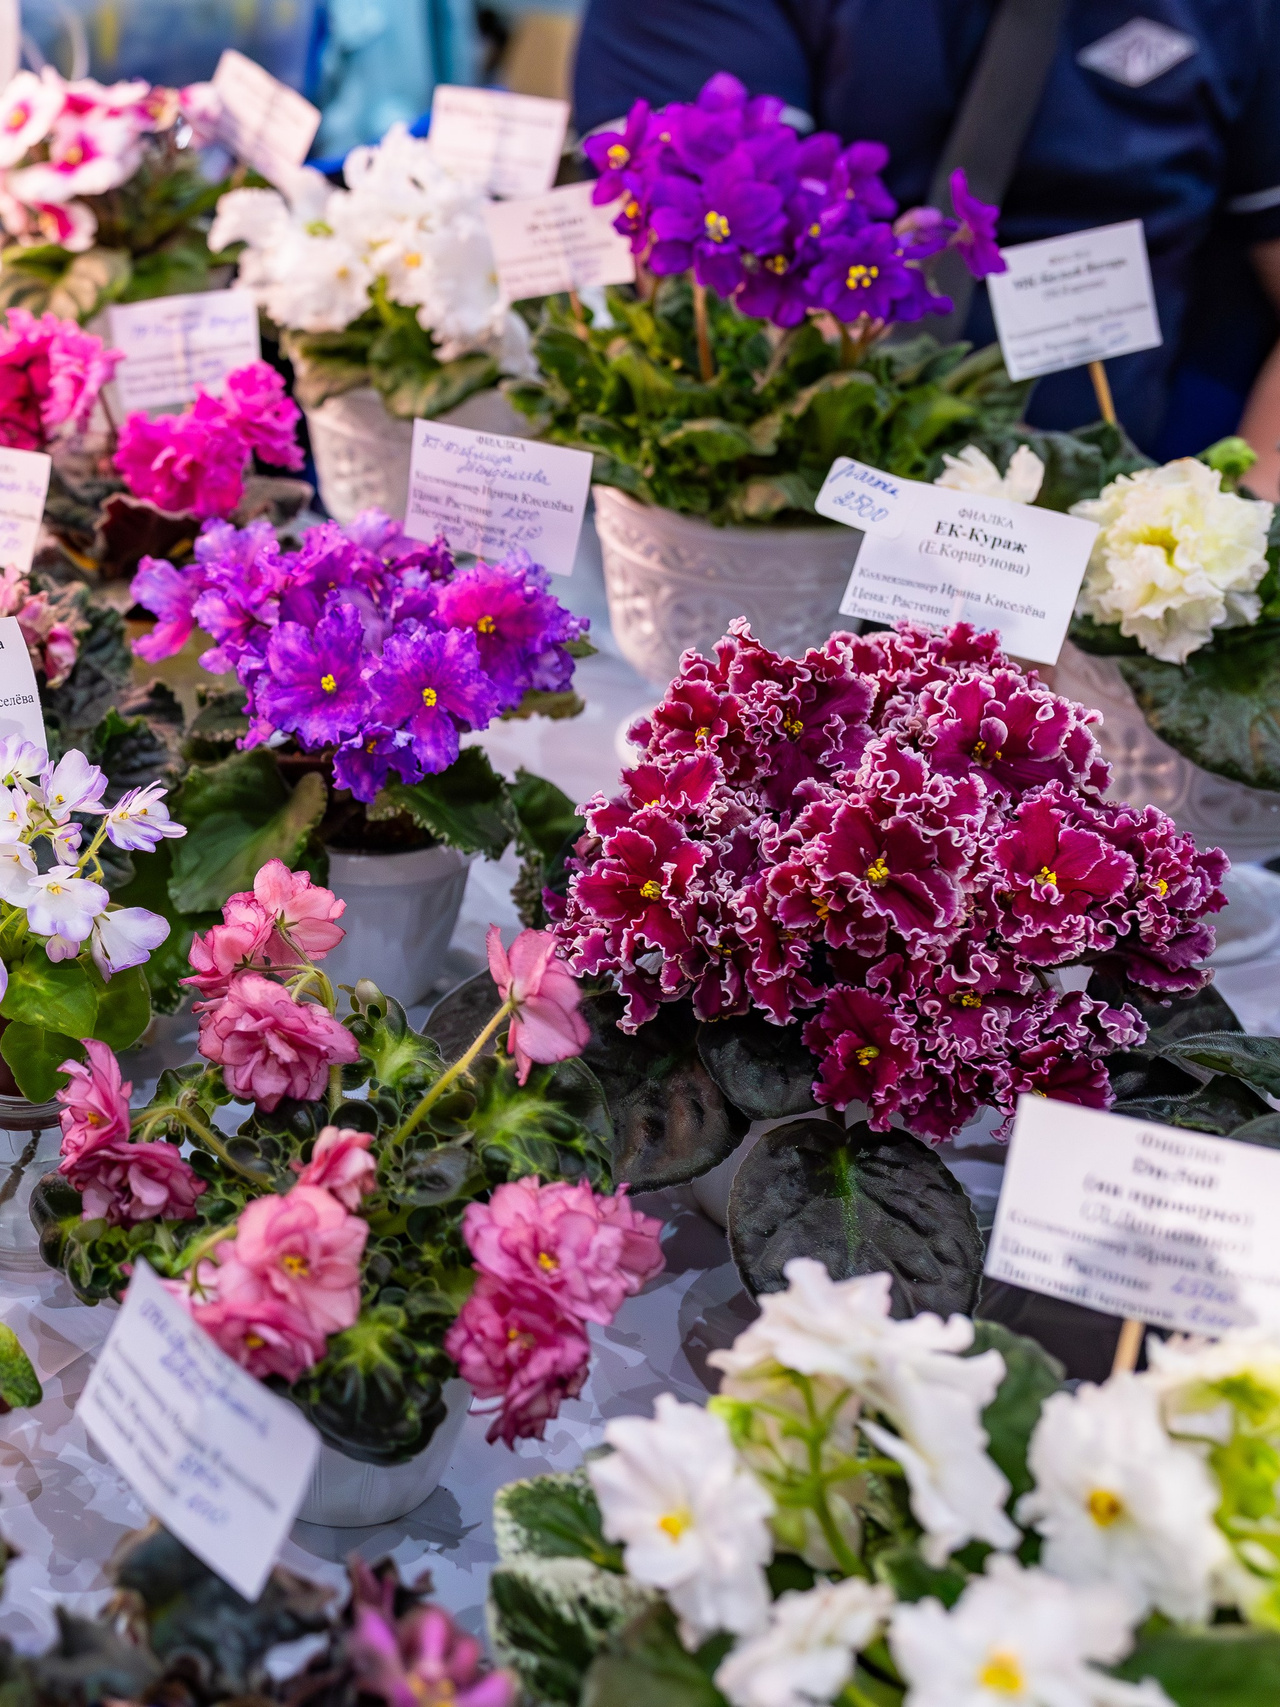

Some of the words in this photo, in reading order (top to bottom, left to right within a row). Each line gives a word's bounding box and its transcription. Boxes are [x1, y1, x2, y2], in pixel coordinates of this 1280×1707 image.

[957, 507, 1014, 530] ФИАЛКА
[934, 520, 1028, 555] ЕК-Кураж
[918, 538, 1031, 578] (Е.Коршунова)
[891, 596, 950, 618] Растение
[939, 582, 982, 602] Ирина
[984, 592, 1047, 620] Киселёва
